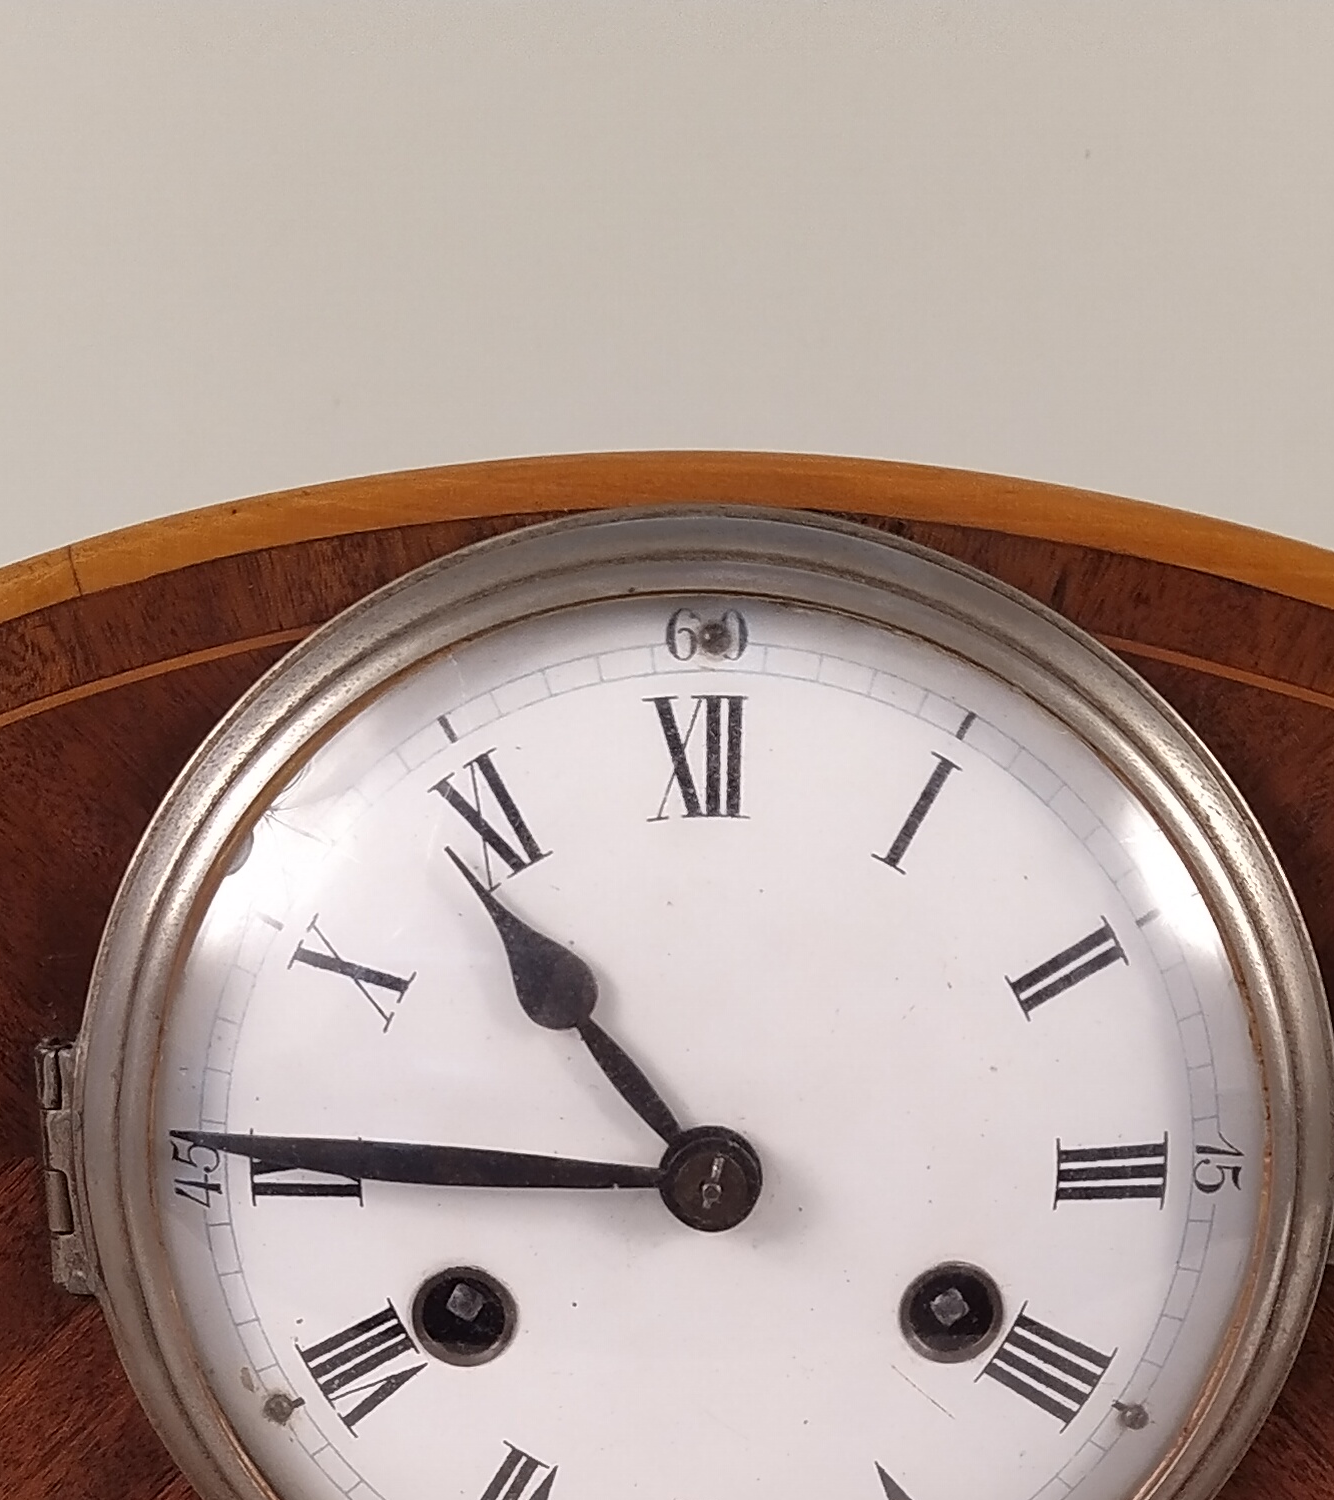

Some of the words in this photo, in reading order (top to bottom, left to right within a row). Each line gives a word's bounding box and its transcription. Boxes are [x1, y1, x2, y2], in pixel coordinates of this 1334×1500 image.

[666, 607, 749, 661] 60
[641, 695, 751, 822] XII
[872, 752, 962, 874] I
[428, 748, 553, 893] XI
[288, 914, 417, 1032] X
[1005, 915, 1129, 1022] II
[170, 1138, 223, 1208] 45
[250, 1128, 363, 1207] I
[1053, 1131, 1168, 1210] III
[1192, 1132, 1245, 1194] 15
[294, 1297, 428, 1437] VIII
[975, 1300, 1118, 1433] IIII
